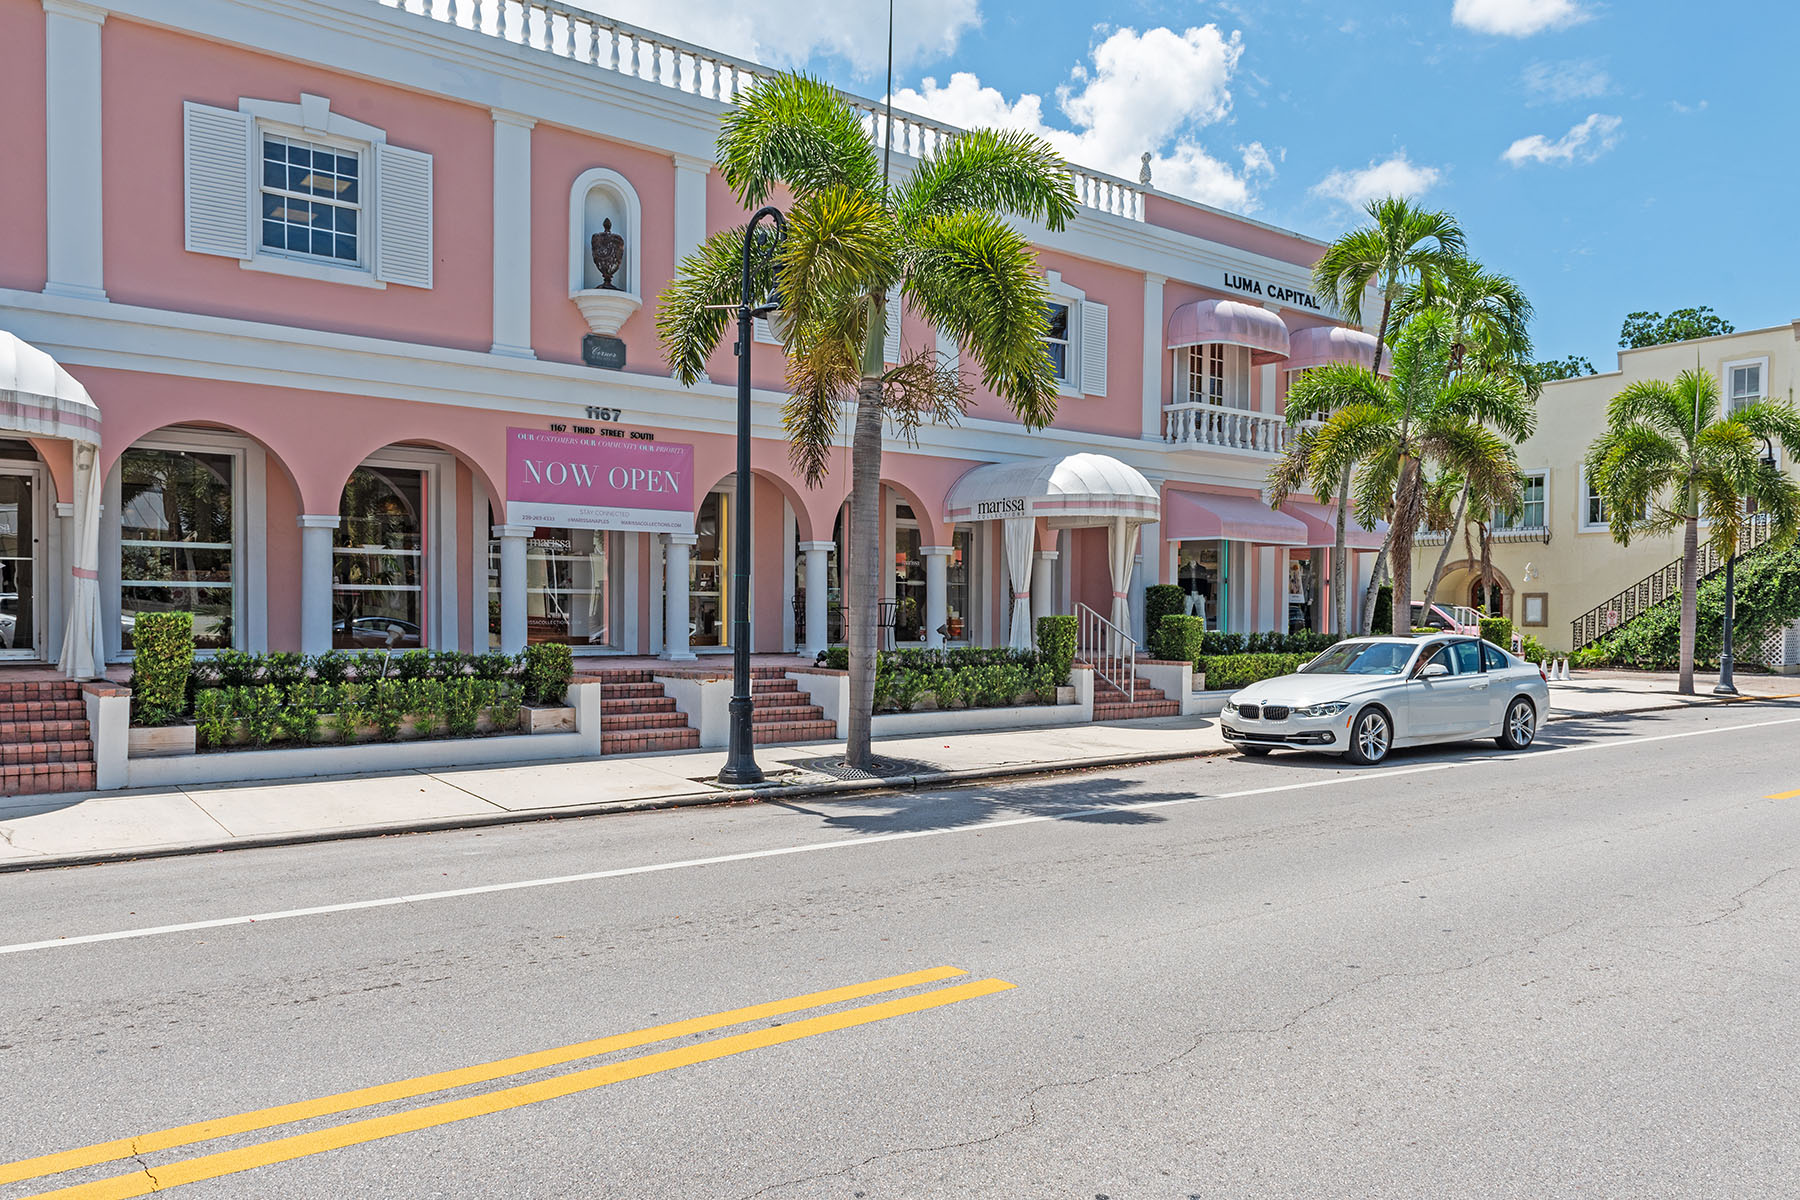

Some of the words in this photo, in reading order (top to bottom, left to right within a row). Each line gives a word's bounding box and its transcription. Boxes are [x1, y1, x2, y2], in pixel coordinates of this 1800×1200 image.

[1224, 273, 1262, 295] LUMA
[1267, 284, 1320, 310] CAPITAL
[585, 406, 622, 422] 1167
[550, 424, 567, 432] 1167
[573, 425, 596, 434] THIRD
[600, 428, 625, 438] STREET
[630, 431, 655, 440] SOUTH
[517, 433, 535, 441] OUR
[536, 434, 579, 445] CUSTOMERS
[598, 440, 637, 450] COMMUNITY
[639, 444, 654, 452] OUR
[522, 459, 599, 488] NOW
[608, 466, 681, 494] OPEN
[594, 510, 630, 518] CONNECTED
[978, 498, 1024, 514] marissa
[977, 511, 1024, 519] COLLECTIONS
[529, 536, 571, 549] marissa
